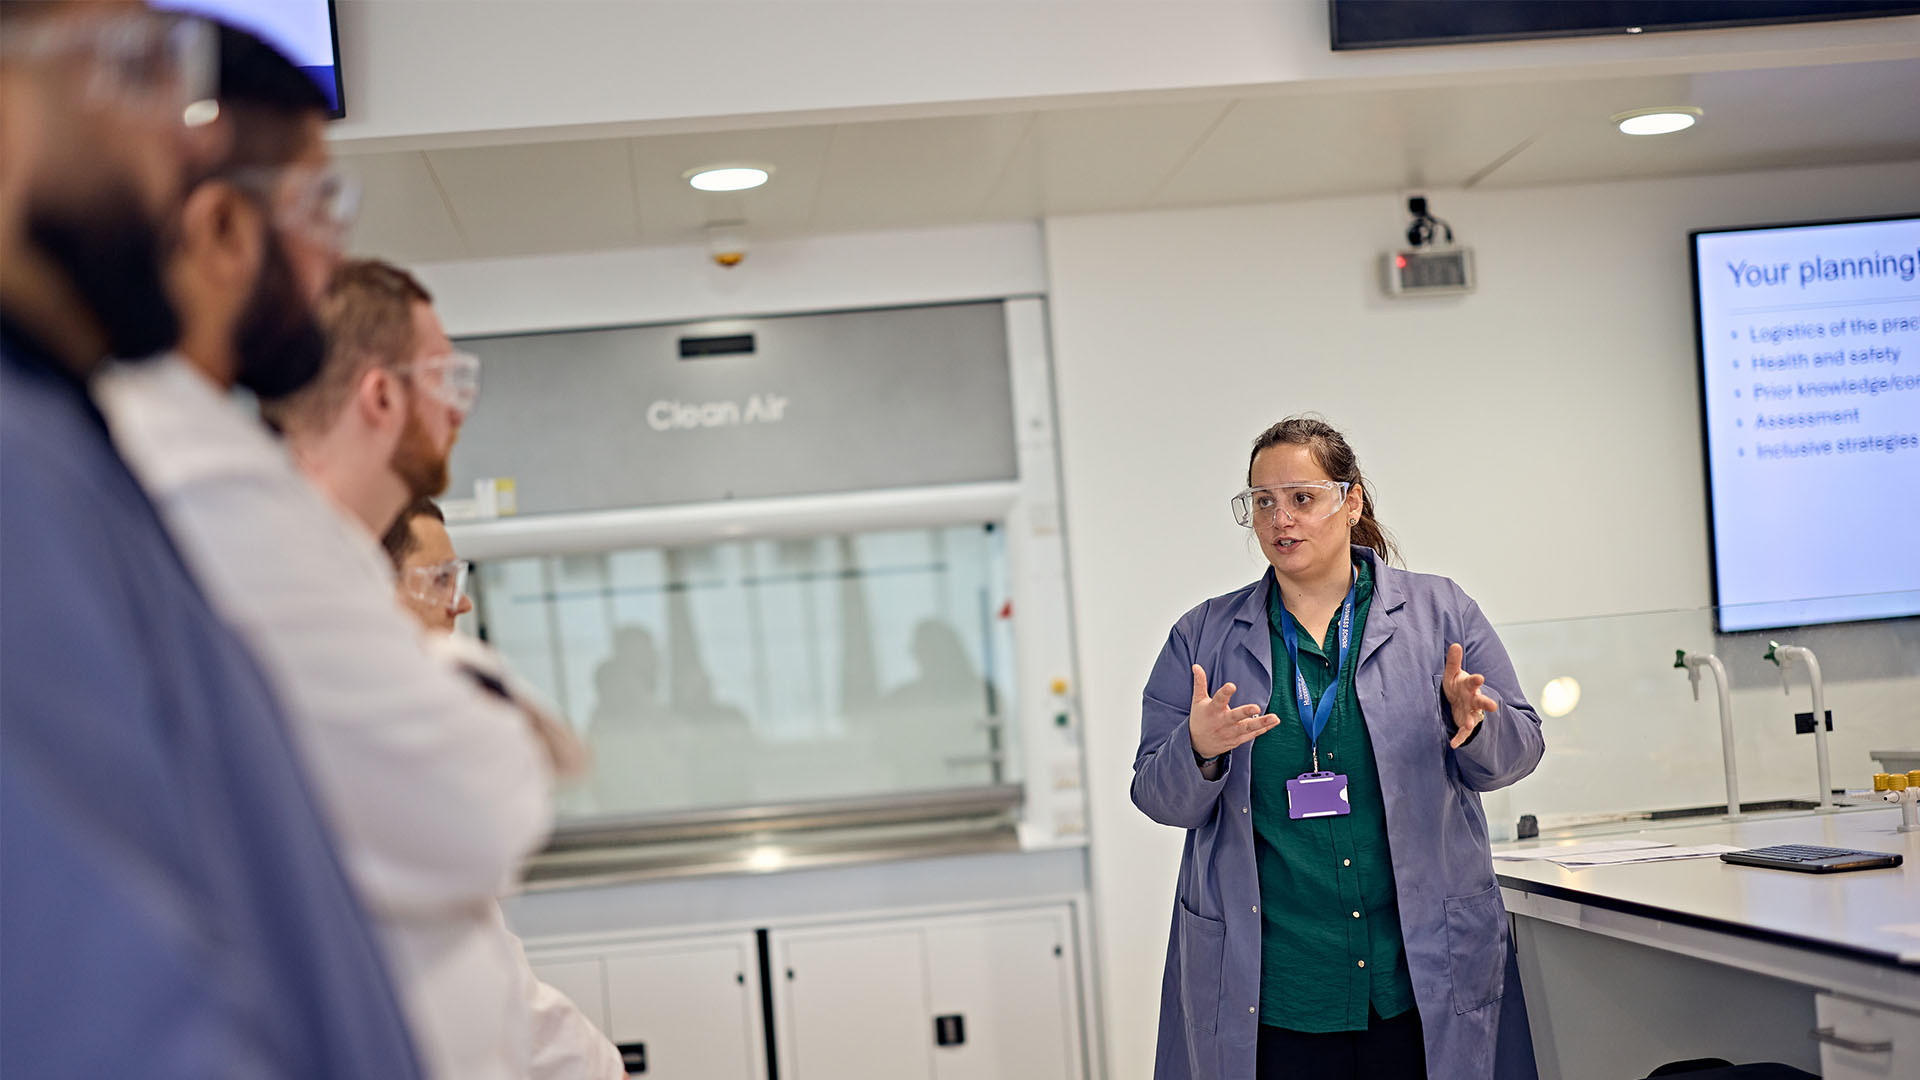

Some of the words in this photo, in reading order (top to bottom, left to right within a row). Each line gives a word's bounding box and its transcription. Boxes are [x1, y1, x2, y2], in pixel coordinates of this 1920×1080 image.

[1727, 259, 1791, 287] Your
[1799, 247, 1920, 289] planning!
[1750, 320, 1825, 345] Logistics
[1830, 318, 1847, 338] of
[1850, 317, 1878, 335] the
[1752, 350, 1810, 370] Health
[1813, 349, 1845, 368] and
[1850, 345, 1901, 366] safety
[1753, 382, 1793, 401] Prior
[647, 400, 740, 430] Clean
[744, 393, 790, 424] Air
[1756, 407, 1860, 430] Assessment
[1757, 438, 1832, 461] Inclusive
[1837, 433, 1920, 455] strategies
